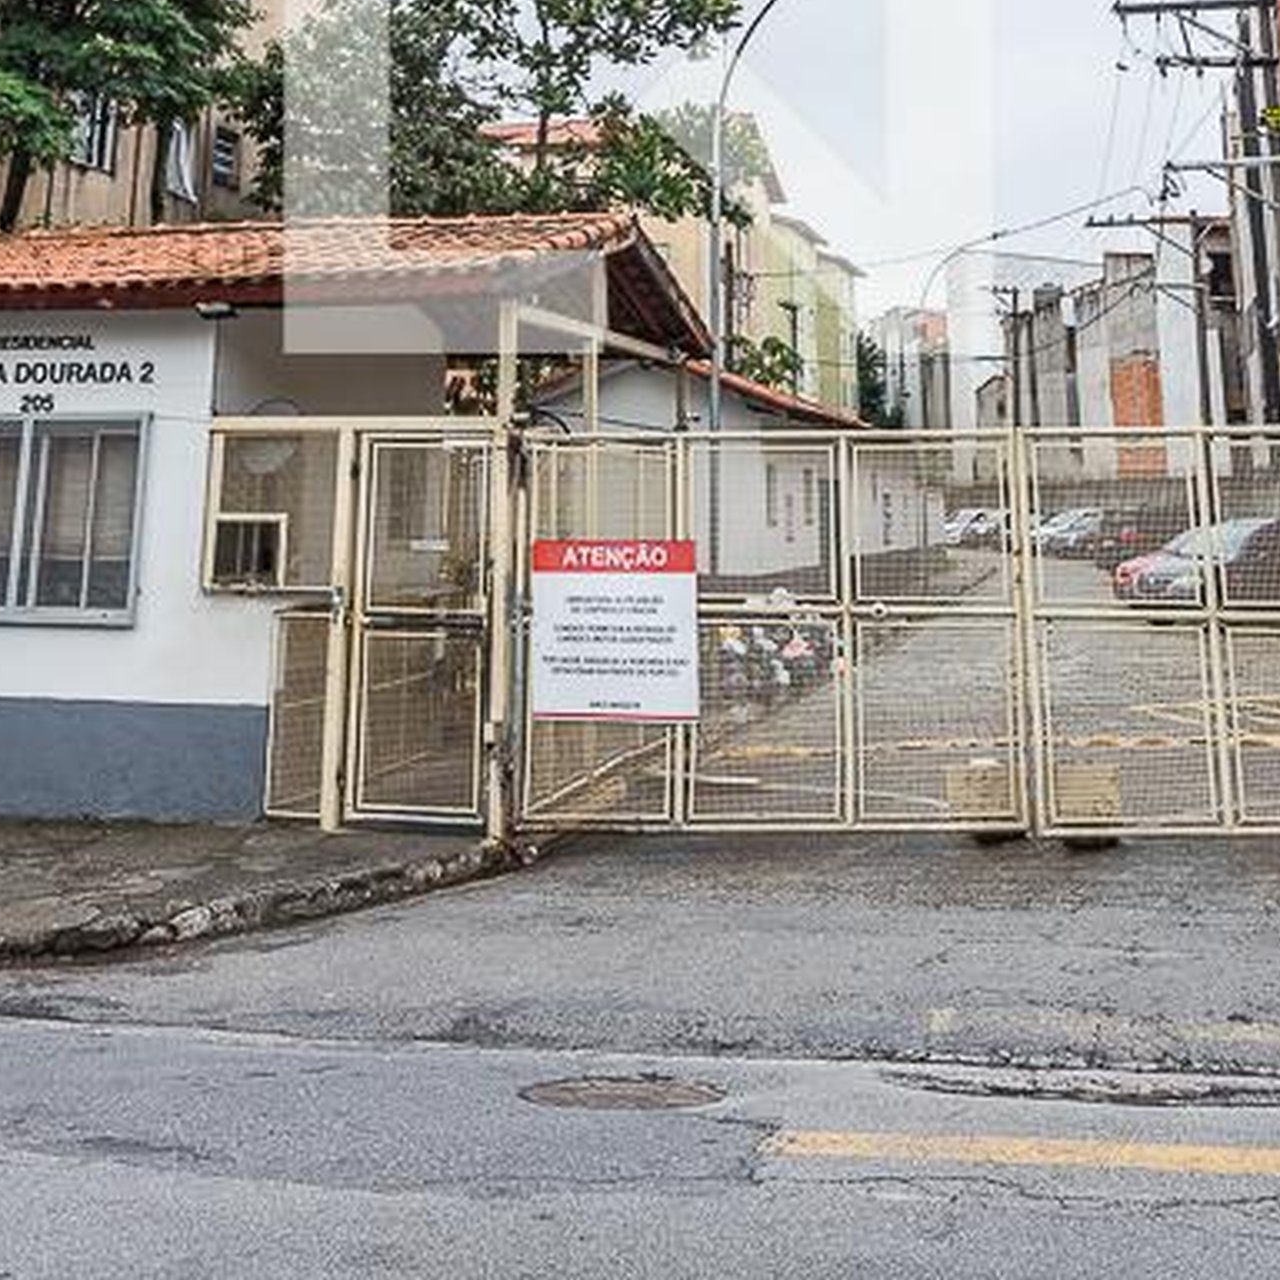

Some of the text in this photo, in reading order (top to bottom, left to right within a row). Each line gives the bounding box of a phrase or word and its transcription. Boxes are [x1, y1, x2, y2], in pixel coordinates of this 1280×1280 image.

[14, 361, 132, 384] DOURADA
[139, 361, 155, 384] 2
[19, 393, 55, 414] 205
[562, 542, 669, 570] ATENÇÃO
